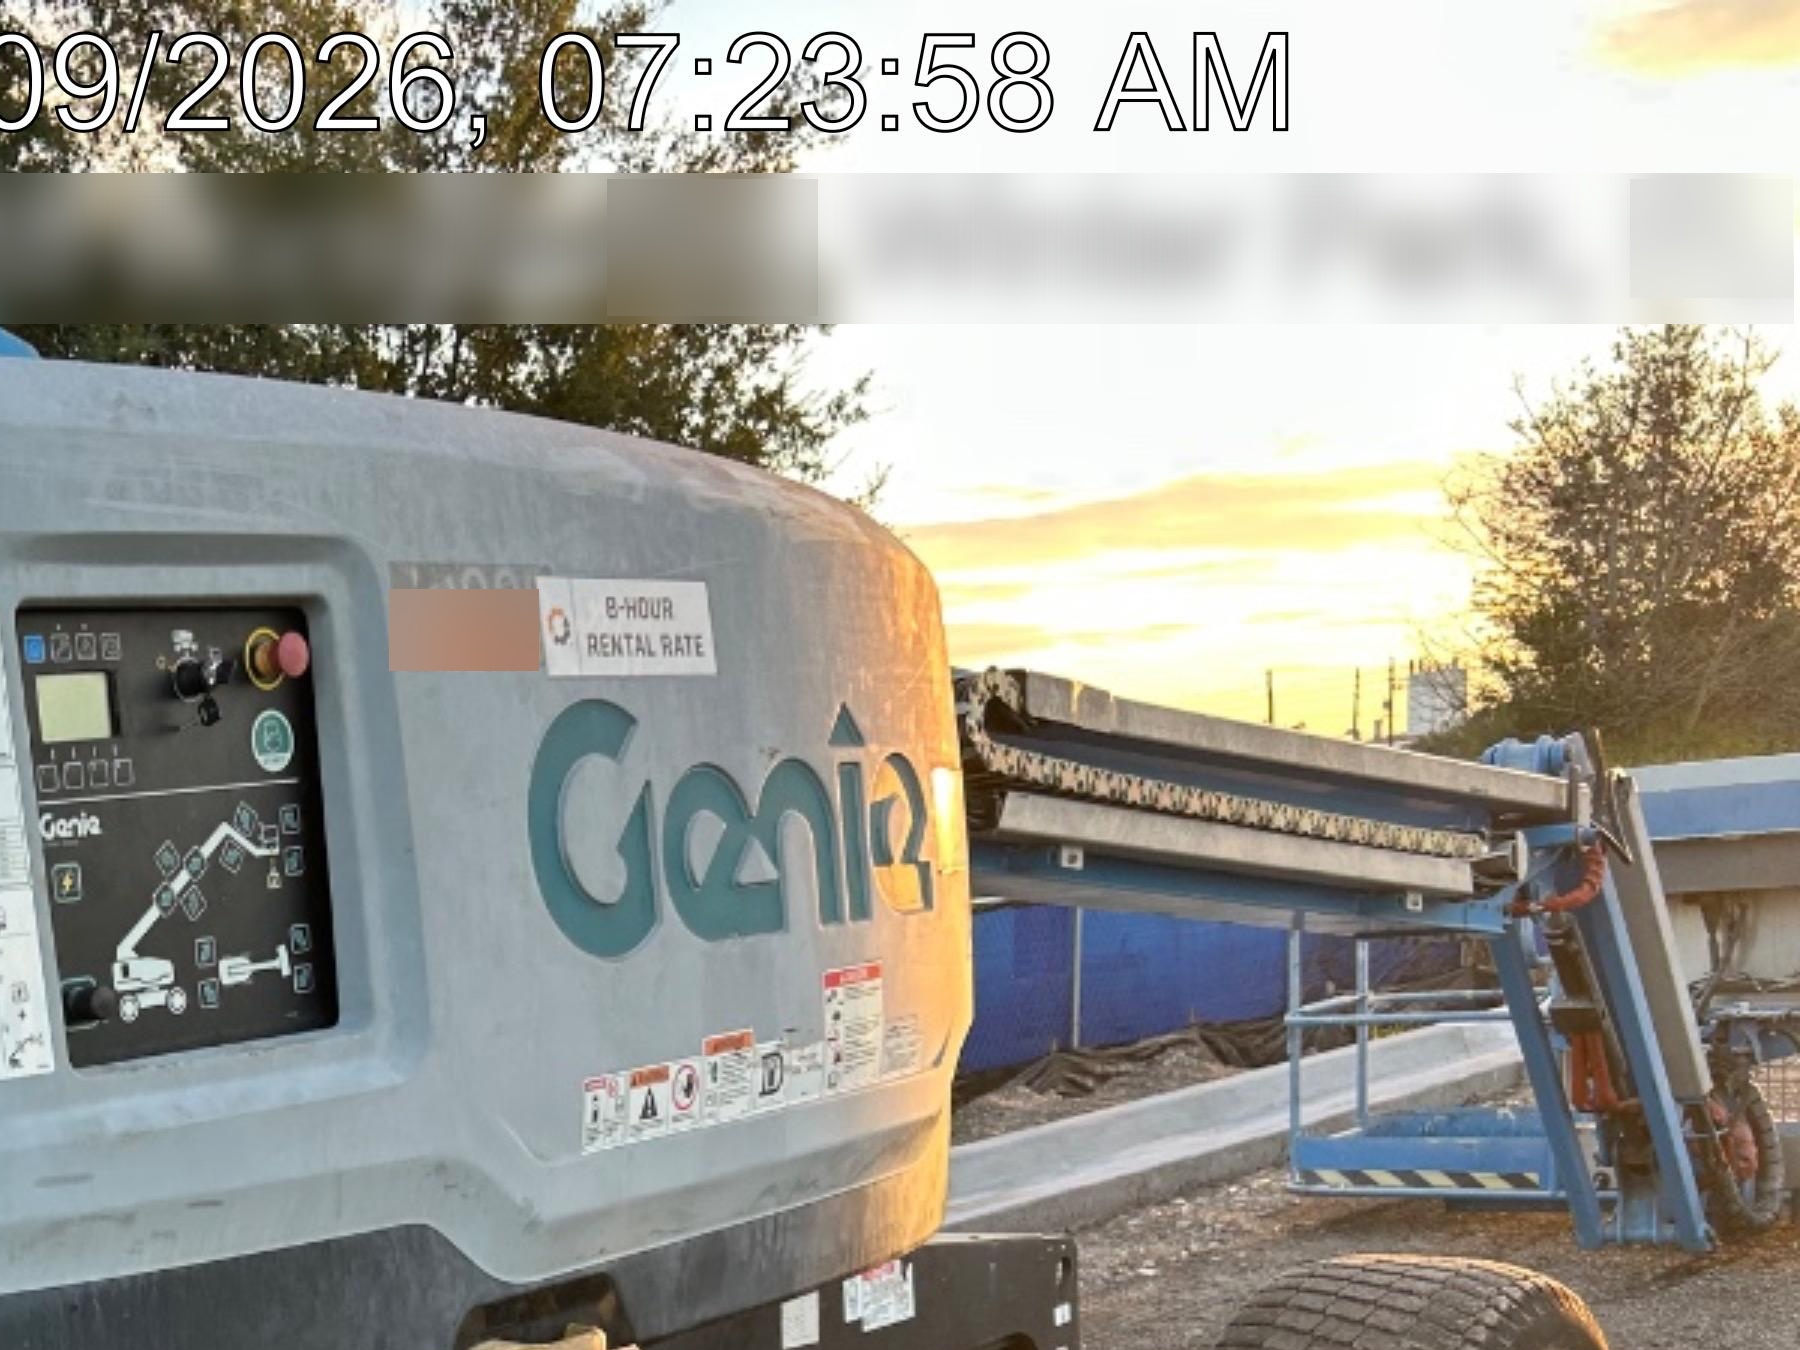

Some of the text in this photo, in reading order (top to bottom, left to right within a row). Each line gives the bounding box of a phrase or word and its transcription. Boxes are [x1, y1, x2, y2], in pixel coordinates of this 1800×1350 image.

[605, 596, 674, 620] 8-HOUR
[586, 634, 706, 658] RENTAL RATE
[39, 811, 103, 841] Genie
[528, 697, 934, 959] Genie
